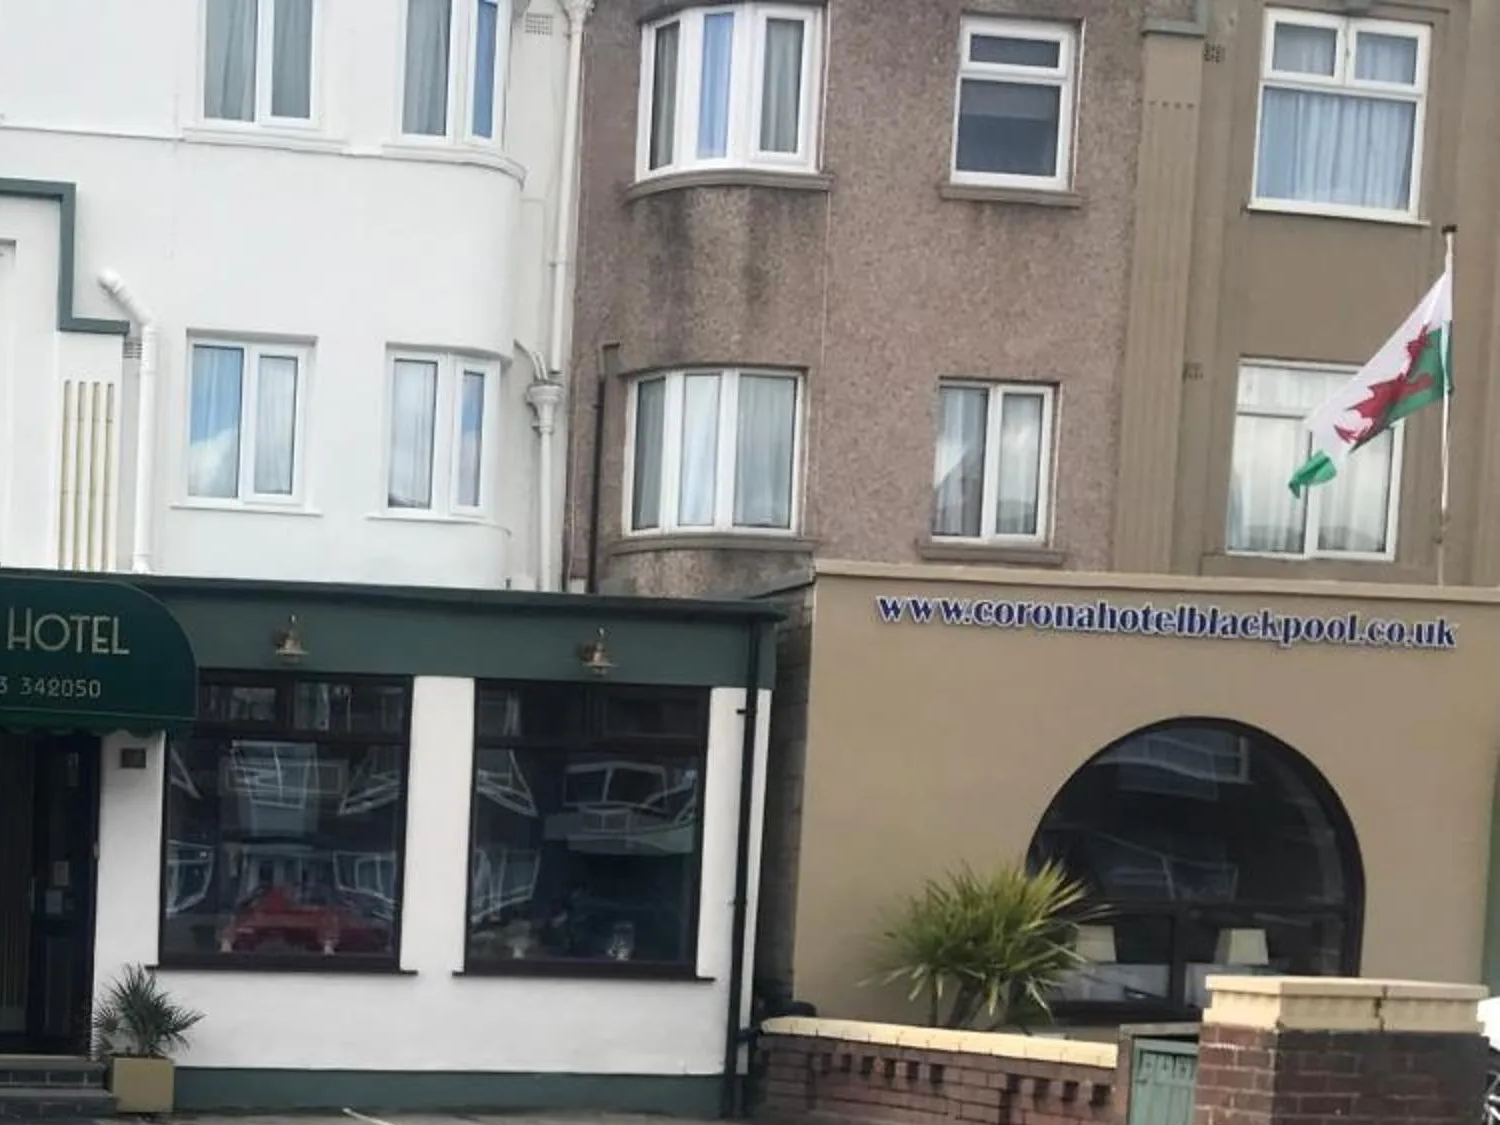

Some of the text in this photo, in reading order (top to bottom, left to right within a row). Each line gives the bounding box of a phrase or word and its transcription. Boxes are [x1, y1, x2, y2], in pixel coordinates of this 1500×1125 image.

[7, 606, 130, 655] HOTEL
[876, 596, 1457, 646] www.coronahotelblackpool.co.uk
[19, 676, 101, 699] 342050
